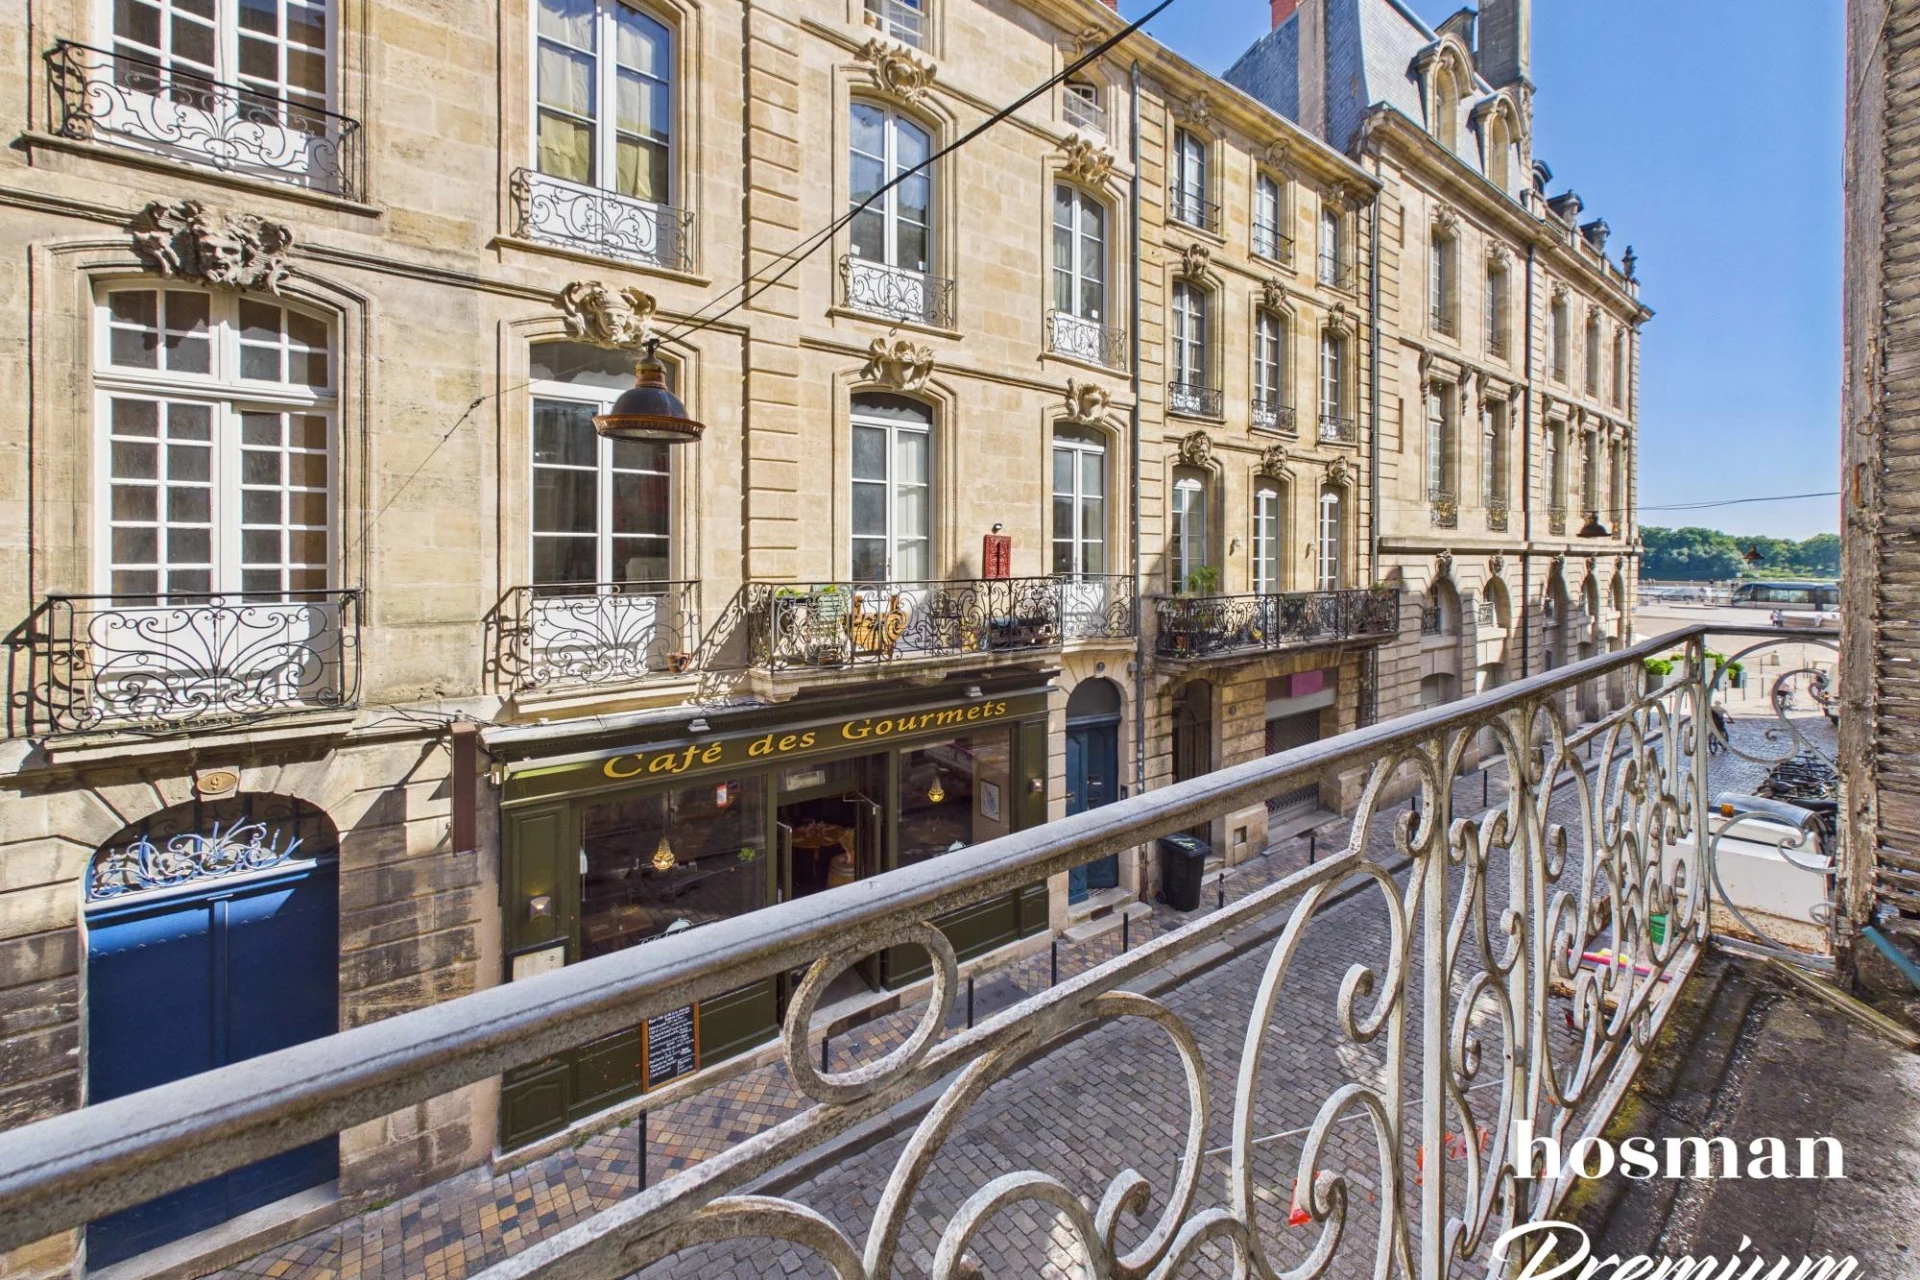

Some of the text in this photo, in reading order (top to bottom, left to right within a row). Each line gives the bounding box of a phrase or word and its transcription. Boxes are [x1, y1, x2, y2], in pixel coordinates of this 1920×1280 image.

[603, 700, 1006, 778] Café des Gourmets
[210, 776, 219, 791] 9
